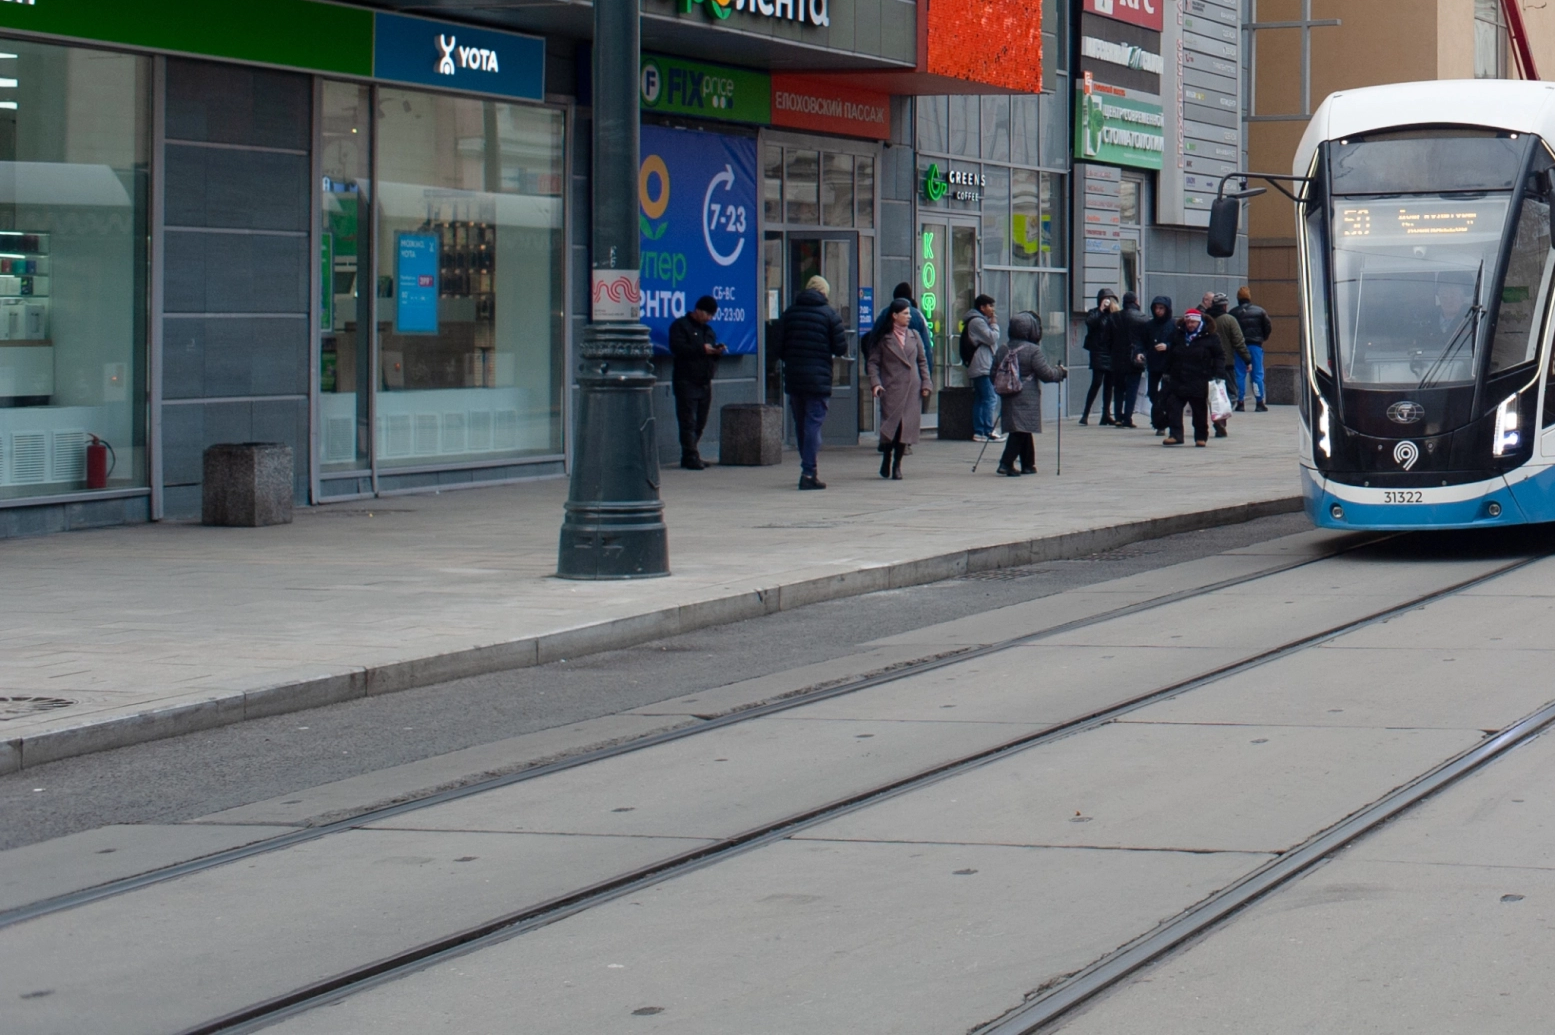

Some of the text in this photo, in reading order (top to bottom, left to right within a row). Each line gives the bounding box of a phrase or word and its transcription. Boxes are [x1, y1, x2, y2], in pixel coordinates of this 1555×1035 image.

[458, 45, 499, 73] YOTA
[703, 76, 735, 98] price
[775, 91, 885, 123] ЕЛОХОВСКИЙ ПАССАЖ
[949, 170, 986, 187] GREENS
[956, 190, 979, 202] COFFEE
[710, 203, 747, 234] 7-23
[1384, 491, 1423, 503] 31322
